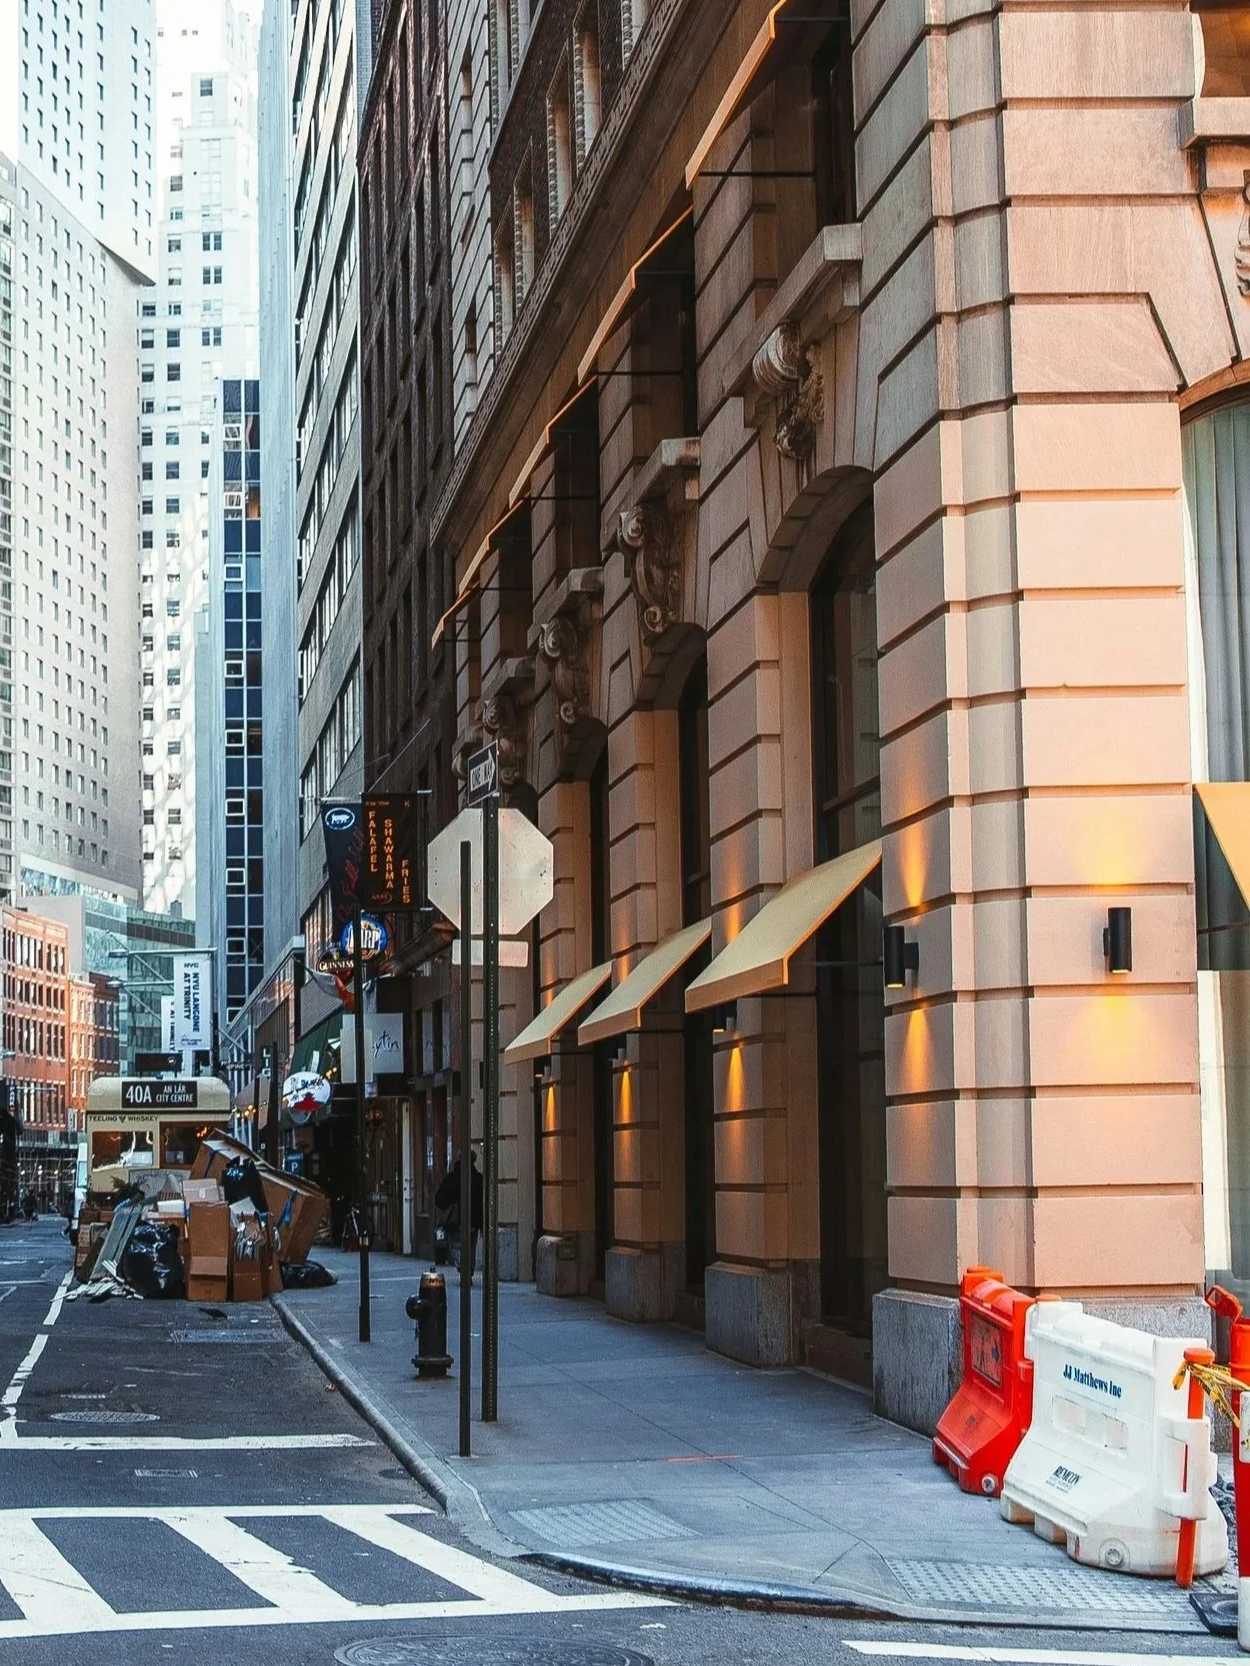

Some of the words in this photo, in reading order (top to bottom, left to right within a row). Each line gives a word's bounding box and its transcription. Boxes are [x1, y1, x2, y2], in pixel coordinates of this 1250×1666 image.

[368, 810, 378, 873] FALAFEL
[383, 819, 394, 889] SHAWARMA
[401, 859, 411, 904] FRIES
[183, 972, 191, 984] AT
[192, 972, 200, 990] NYU
[319, 960, 355, 971] GUINNESS
[183, 986, 191, 1020] TRINITY
[192, 992, 200, 1033] LANGONE
[371, 1030, 400, 1058] ytin
[126, 1084, 152, 1103] 40A
[163, 1085, 172, 1094] AN
[155, 1093, 169, 1103] CITY
[170, 1093, 194, 1103] CENTRE
[1063, 1363, 1072, 1380] JJ
[1073, 1367, 1108, 1393] Matthews
[1109, 1380, 1122, 1398] Inc
